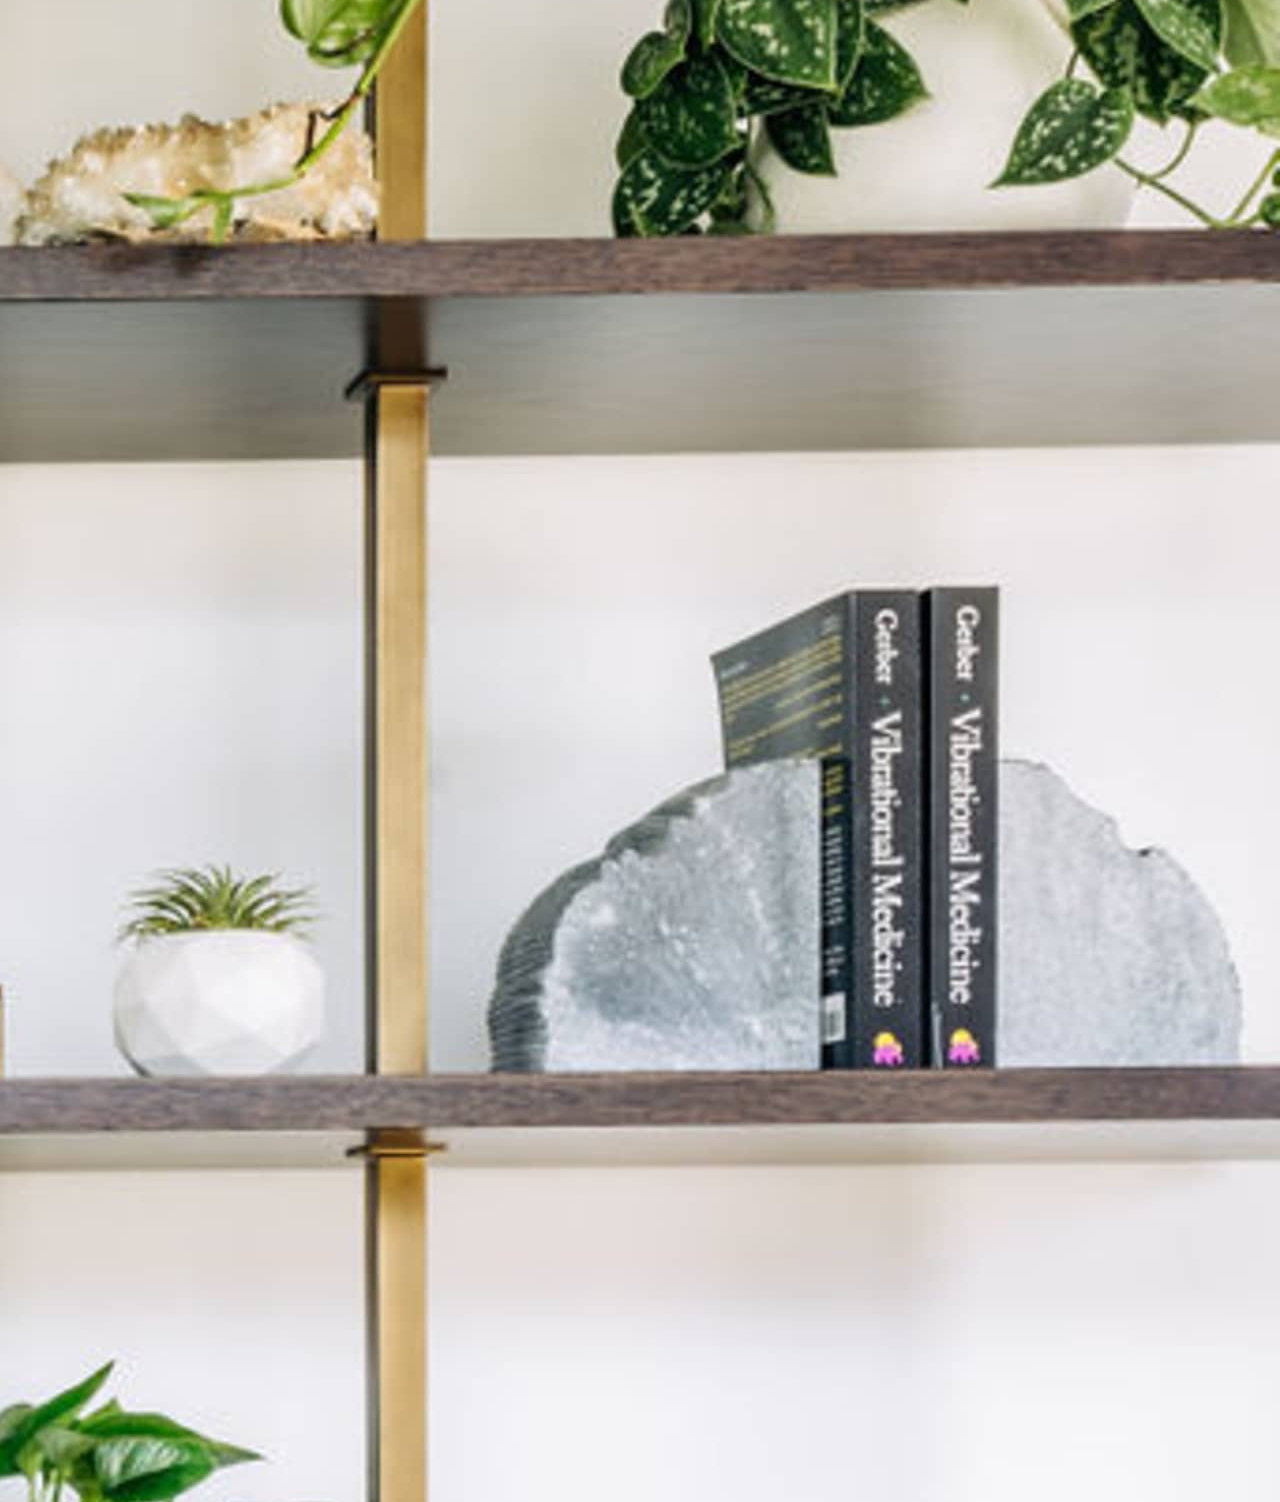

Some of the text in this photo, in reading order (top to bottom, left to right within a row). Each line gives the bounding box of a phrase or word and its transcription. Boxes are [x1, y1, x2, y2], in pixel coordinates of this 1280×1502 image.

[870, 608, 905, 1007] Gerber Vibrational Medicine
[948, 604, 983, 1005] Gerber Vibrational Medicine
